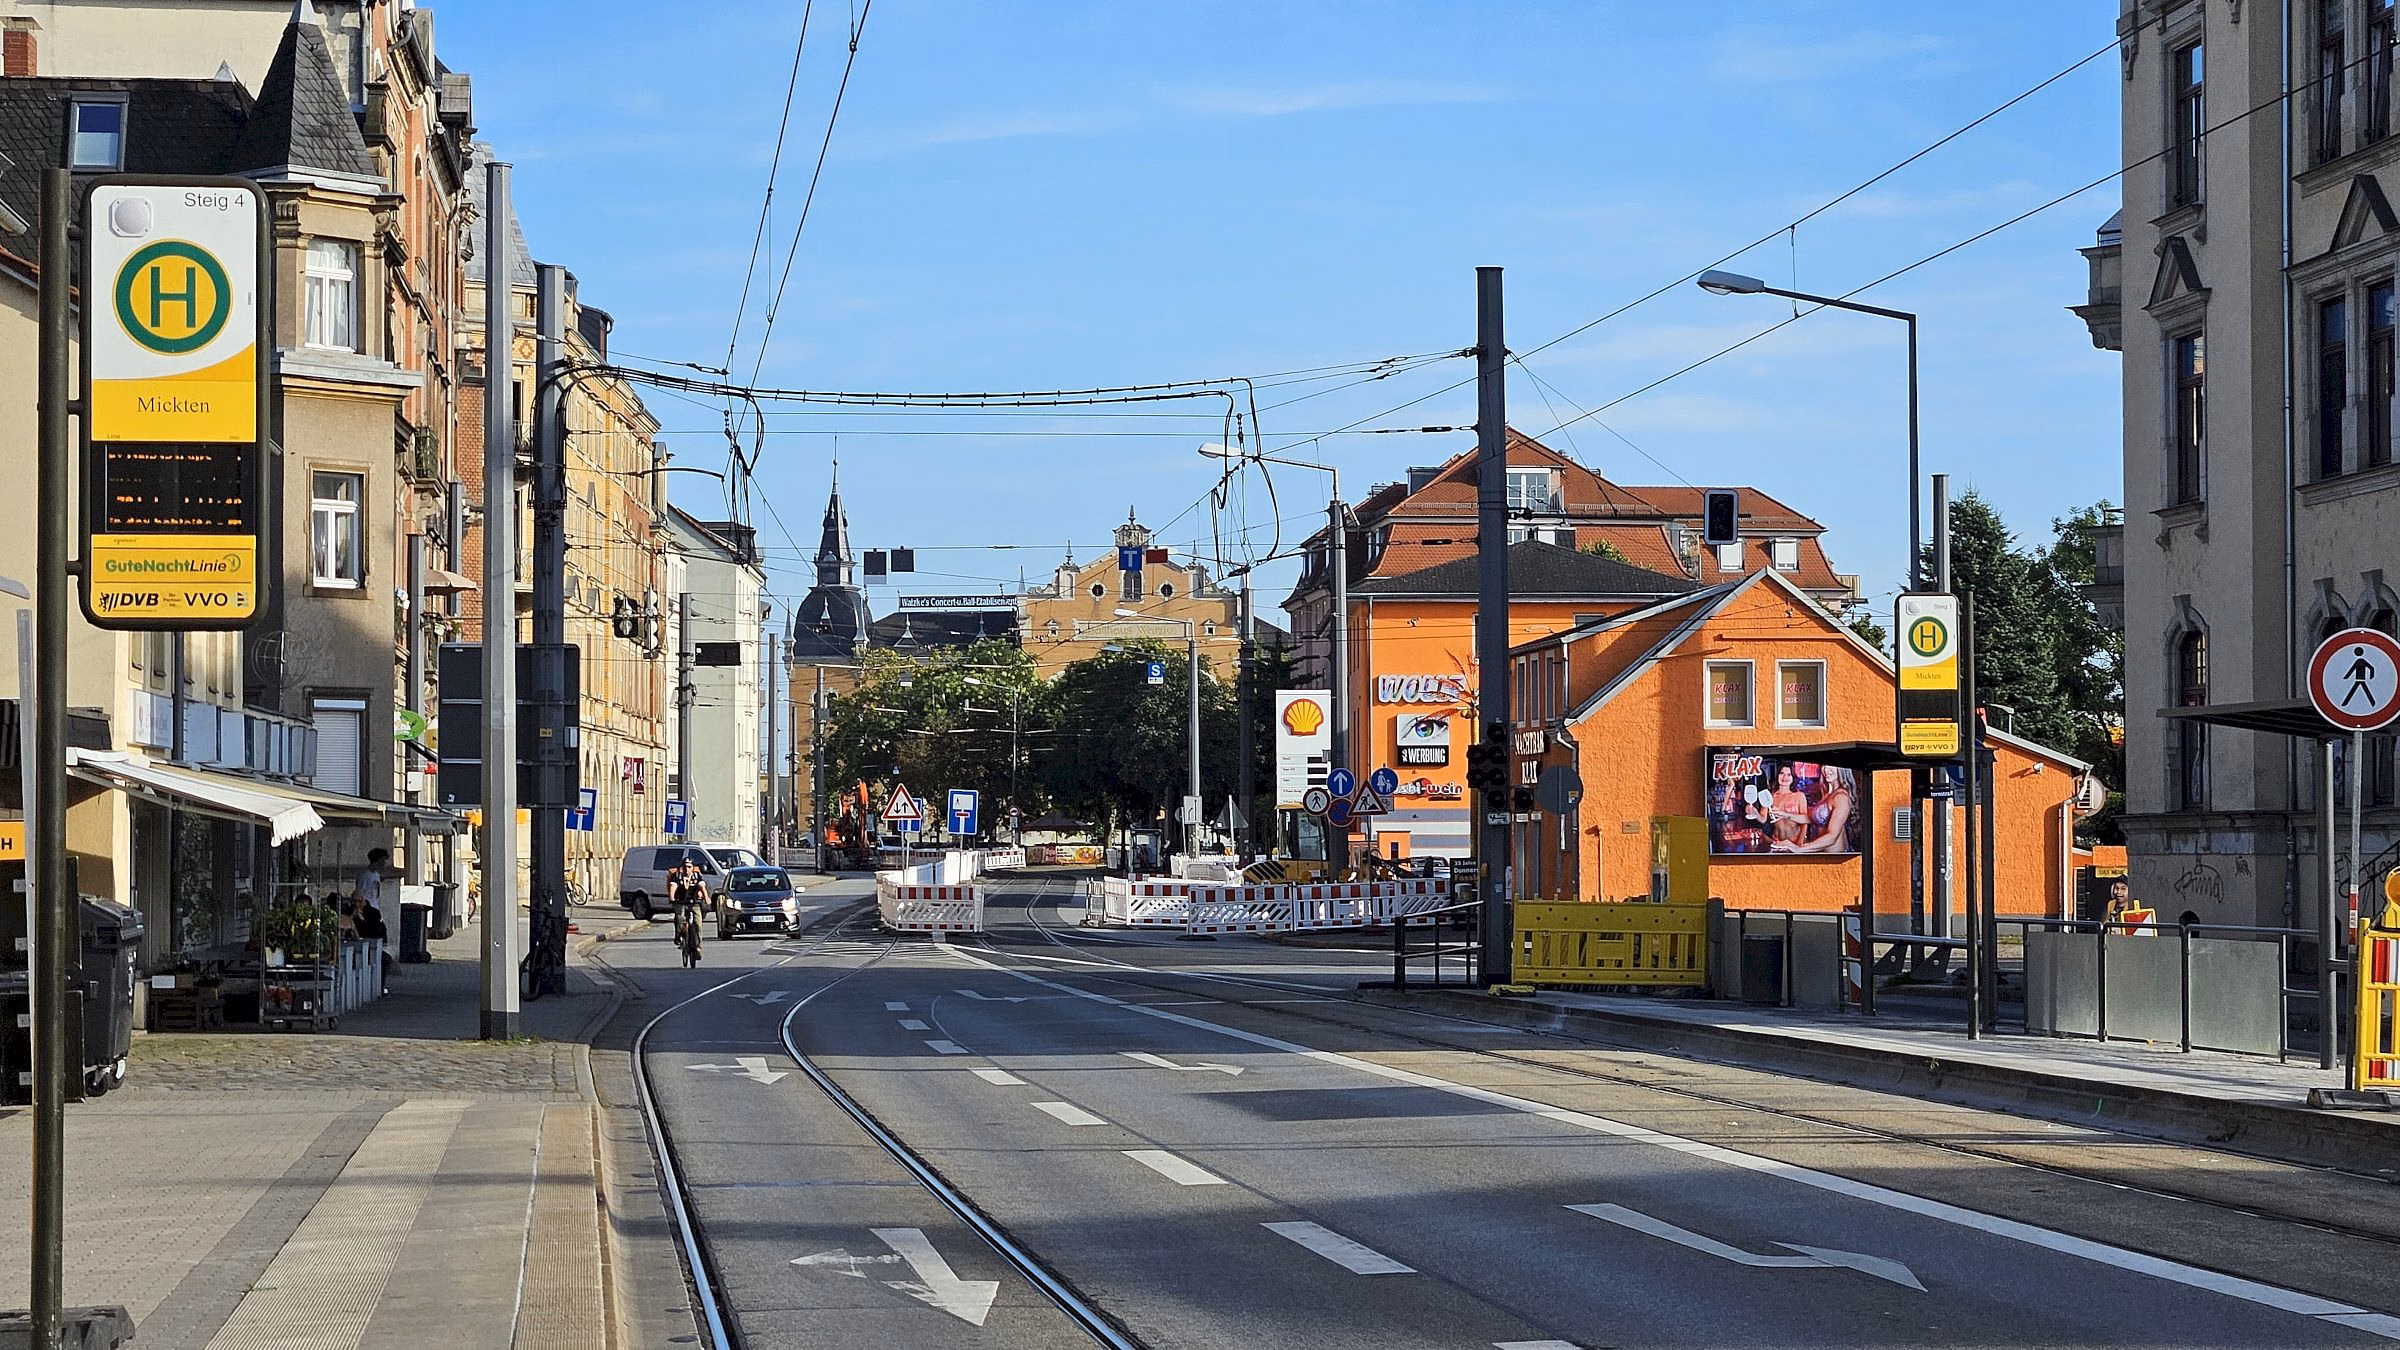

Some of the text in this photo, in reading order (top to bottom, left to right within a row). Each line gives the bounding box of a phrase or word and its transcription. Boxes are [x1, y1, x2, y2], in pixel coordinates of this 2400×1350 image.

[184, 192, 245, 212] Steig 4
[150, 266, 196, 328] H
[137, 396, 210, 413] Mickten
[1123, 550, 1138, 568] T
[120, 592, 159, 607] DVB
[184, 592, 229, 607] VVO
[1919, 625, 1936, 648] H
[1151, 664, 1161, 676] S
[1915, 672, 1942, 680] Mickten
[1714, 682, 1742, 694] KLAX
[1785, 682, 1812, 694] KLAX
[1408, 748, 1446, 763] WERBUNG
[1713, 756, 1763, 780] KLAX
